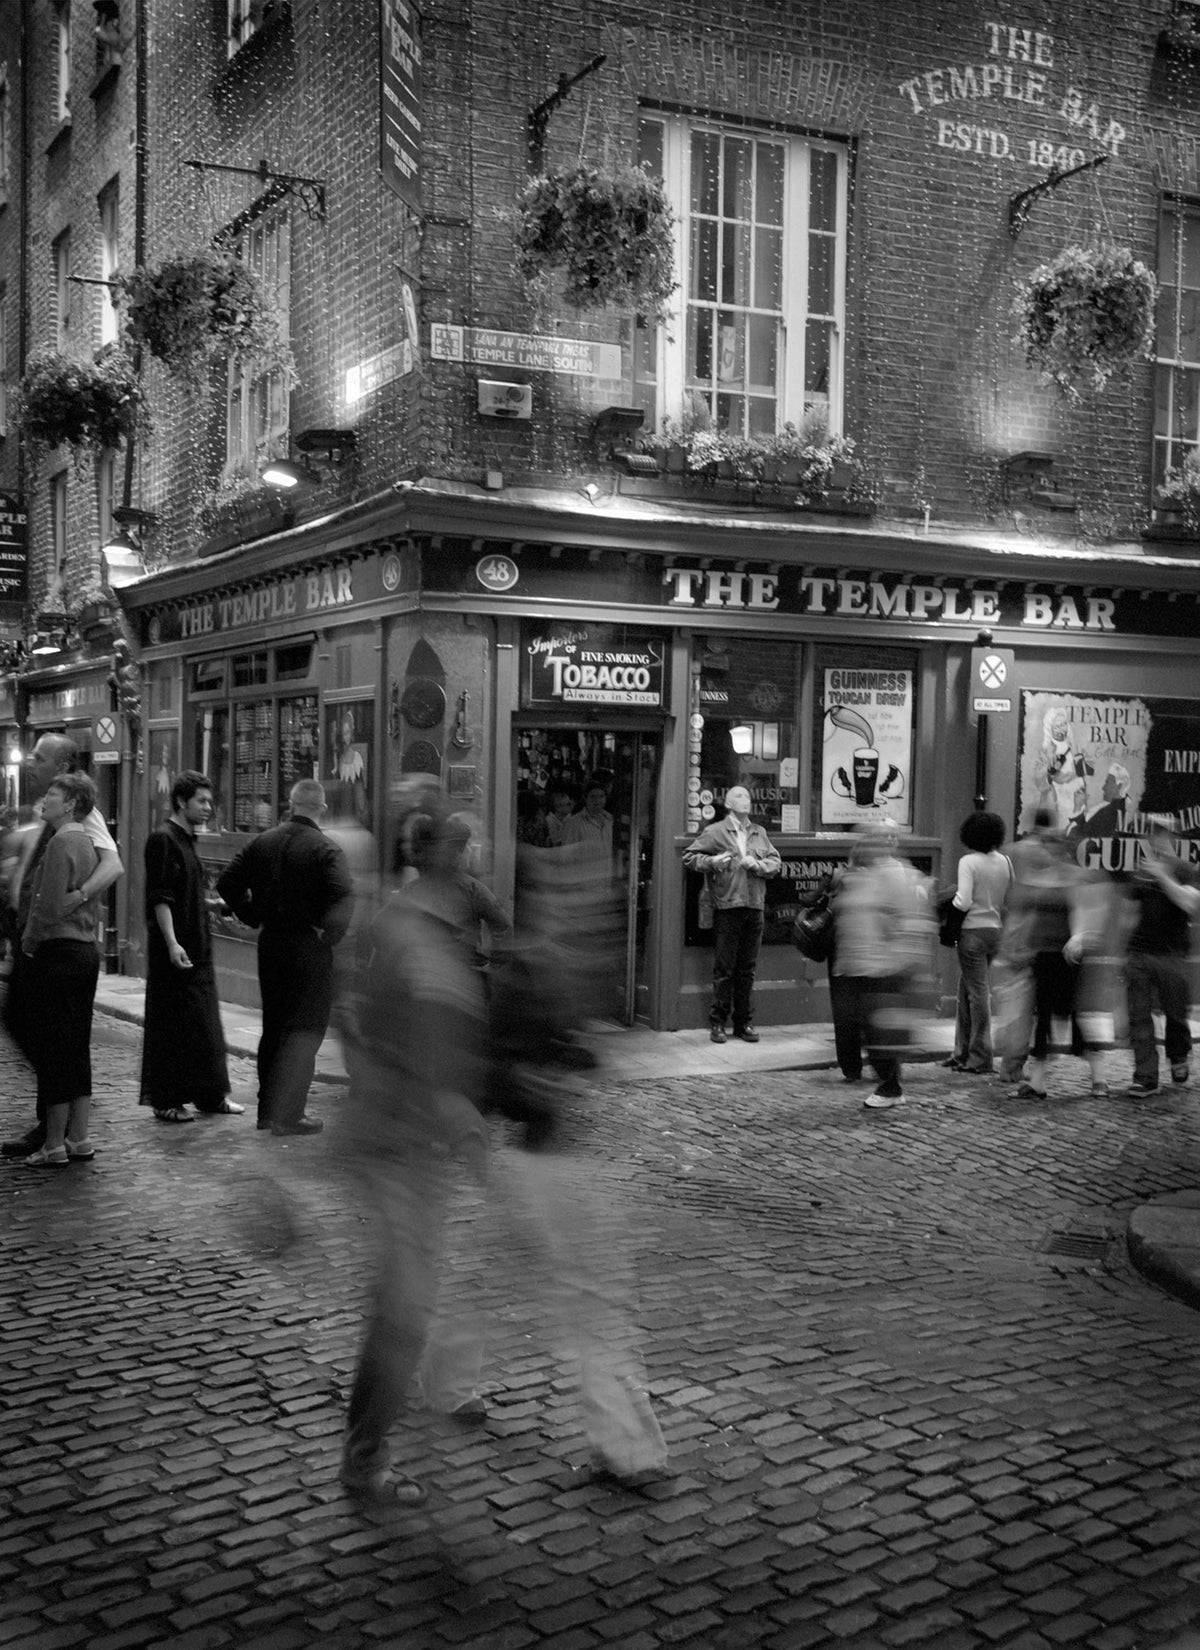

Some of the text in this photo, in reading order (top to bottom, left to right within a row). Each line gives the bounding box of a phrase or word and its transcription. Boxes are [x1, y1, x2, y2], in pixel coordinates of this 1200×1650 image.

[984, 22, 1054, 67] THE
[391, 35, 414, 80] BAR
[399, 100, 421, 132] GARDEN
[898, 64, 1127, 156] TEMPLE BAR
[386, 132, 401, 155] LIVE
[937, 119, 1086, 168] ESTD. 1840
[471, 347, 593, 372] TEMPLE LANE SOUTH
[0, 513, 27, 525] PLE
[385, 564, 398, 583] 48
[483, 560, 510, 581] 48
[179, 604, 213, 637] THE
[219, 582, 297, 629] TEMPLE
[306, 568, 353, 609] BAR
[664, 568, 1116, 630] THE TEMPLE BAR
[527, 630, 588, 656] Importers
[565, 645, 577, 653] OF
[581, 651, 650, 665] FINE SMOKING
[543, 656, 651, 696] TOBACCO
[830, 670, 907, 692] GUINNESS
[565, 690, 658, 703] Always in Stock
[828, 691, 907, 707] TOUCAN BREW
[1066, 706, 1147, 726] TEMPLE
[1090, 726, 1128, 746] BAR
[1164, 749, 1200, 773] EMP
